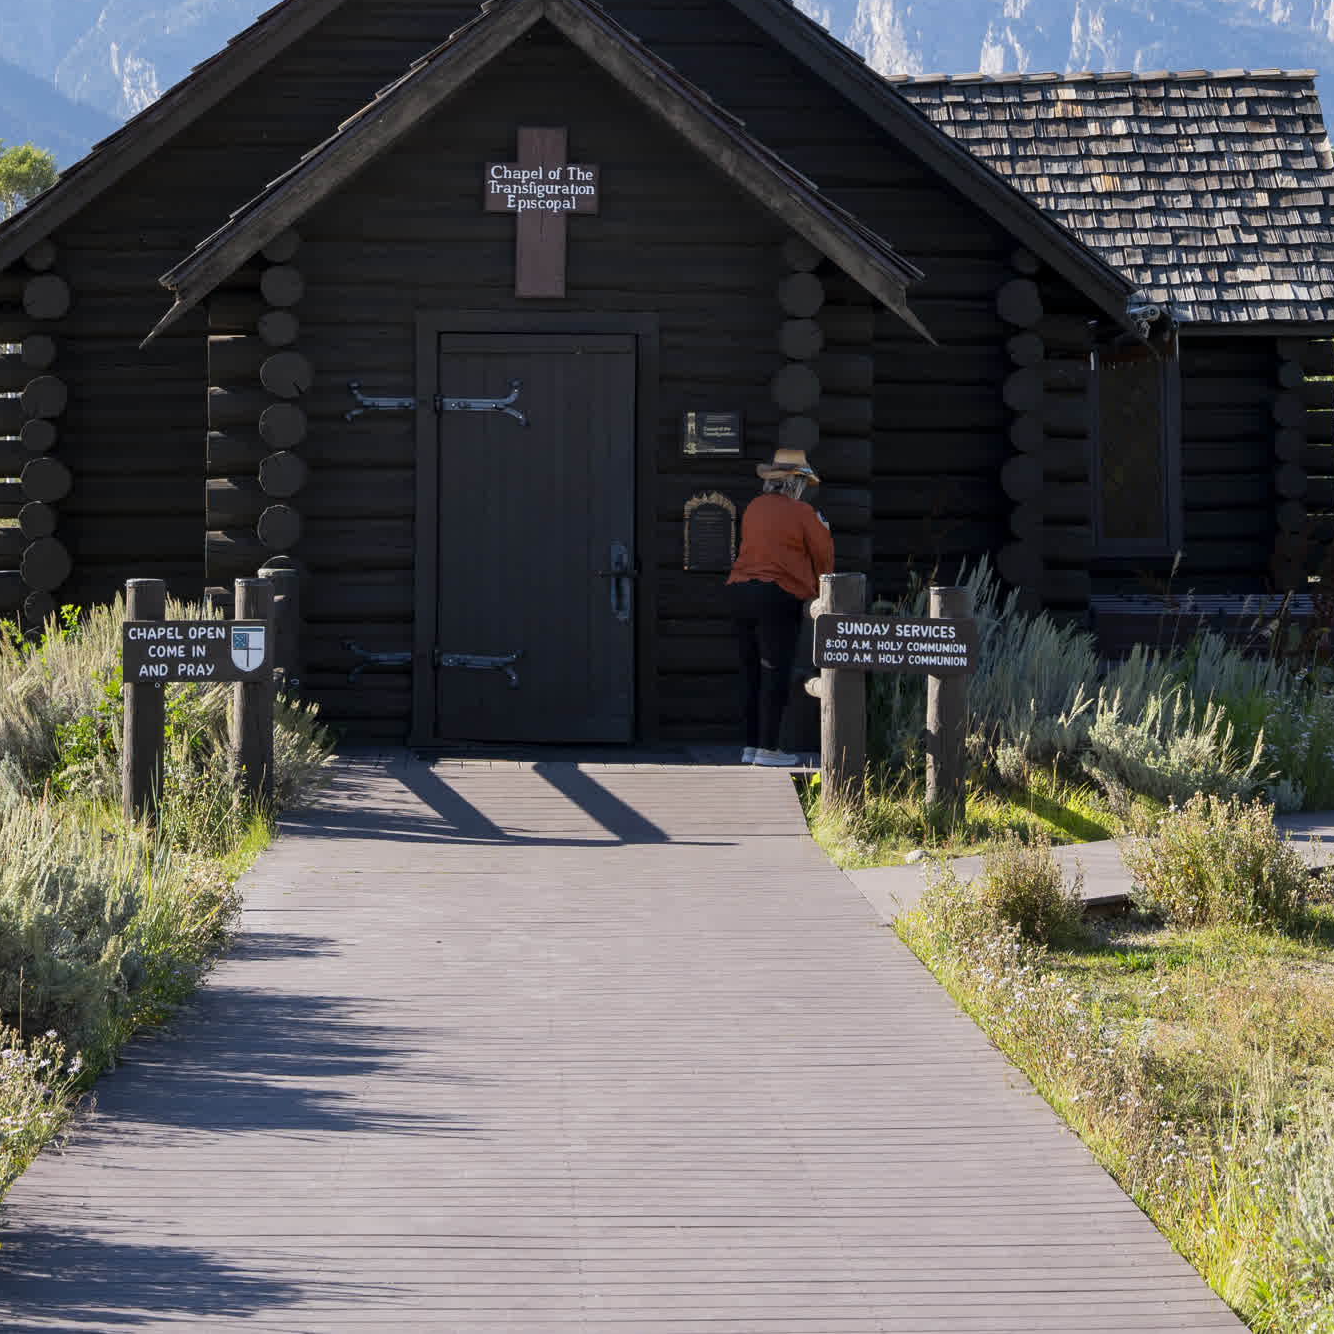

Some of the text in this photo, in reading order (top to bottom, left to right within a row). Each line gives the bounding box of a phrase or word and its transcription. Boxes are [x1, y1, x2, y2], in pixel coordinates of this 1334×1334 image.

[490, 165, 594, 184] Chapel of The
[487, 179, 596, 199] Transfiguration
[506, 193, 577, 214] Episcopal
[128, 626, 226, 640] CHAPEL OPEN
[836, 621, 956, 639] SUNDAY SERVICES
[148, 645, 206, 658] COME IN
[825, 638, 967, 654] 8:00 A.M. HOLY COMMUNION
[823, 651, 968, 667] 10:00 A.M. HOLY COMMUNION
[138, 663, 215, 677] AND PRAY
